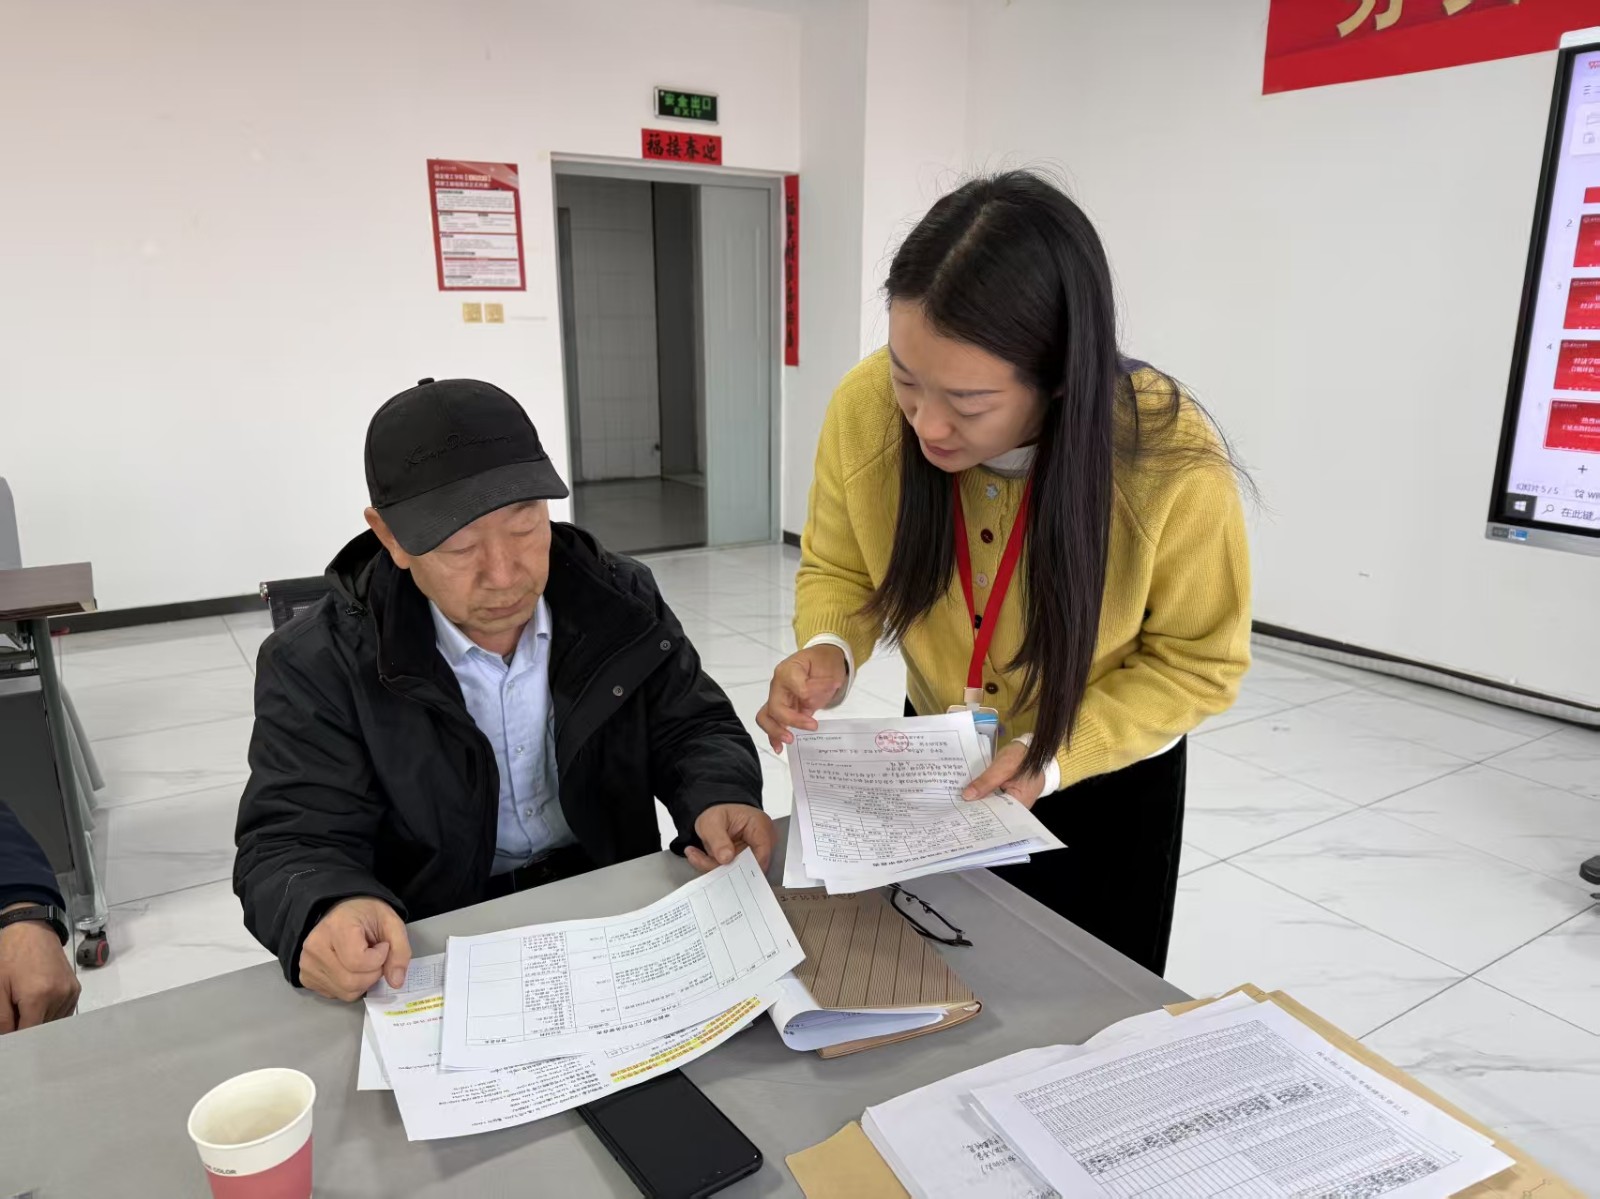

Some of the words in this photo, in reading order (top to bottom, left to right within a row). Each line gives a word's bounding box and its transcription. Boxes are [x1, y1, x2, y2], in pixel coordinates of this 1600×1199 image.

[664, 92, 711, 111] 安全出口
[673, 107, 702, 118] EXIT
[1566, 218, 1573, 228] 2
